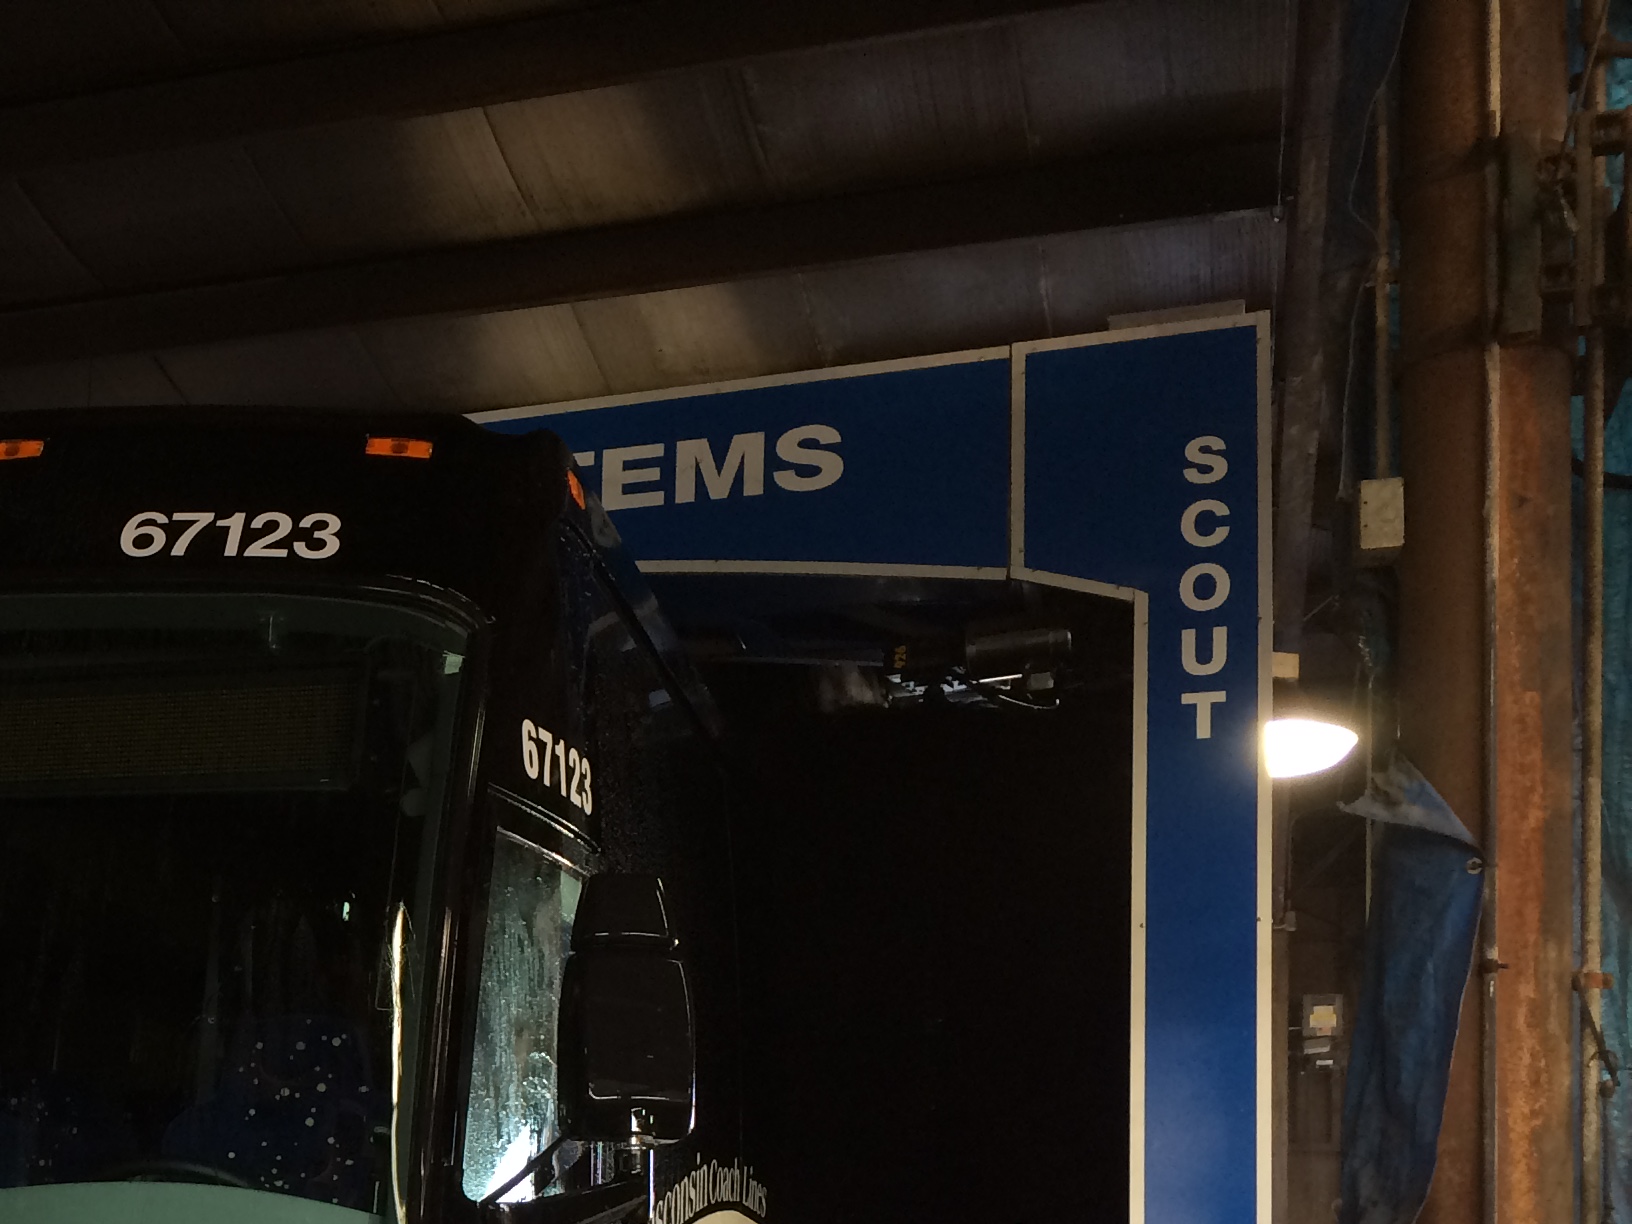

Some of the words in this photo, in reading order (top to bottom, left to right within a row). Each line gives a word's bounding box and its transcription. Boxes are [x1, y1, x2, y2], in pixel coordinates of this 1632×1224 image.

[573, 423, 845, 512] EMS
[120, 511, 342, 560] 67123
[1179, 435, 1231, 740] SCOUT
[521, 718, 593, 816] 67123
[709, 1157, 741, 1204] Coach
[742, 1165, 768, 1218] Lines
